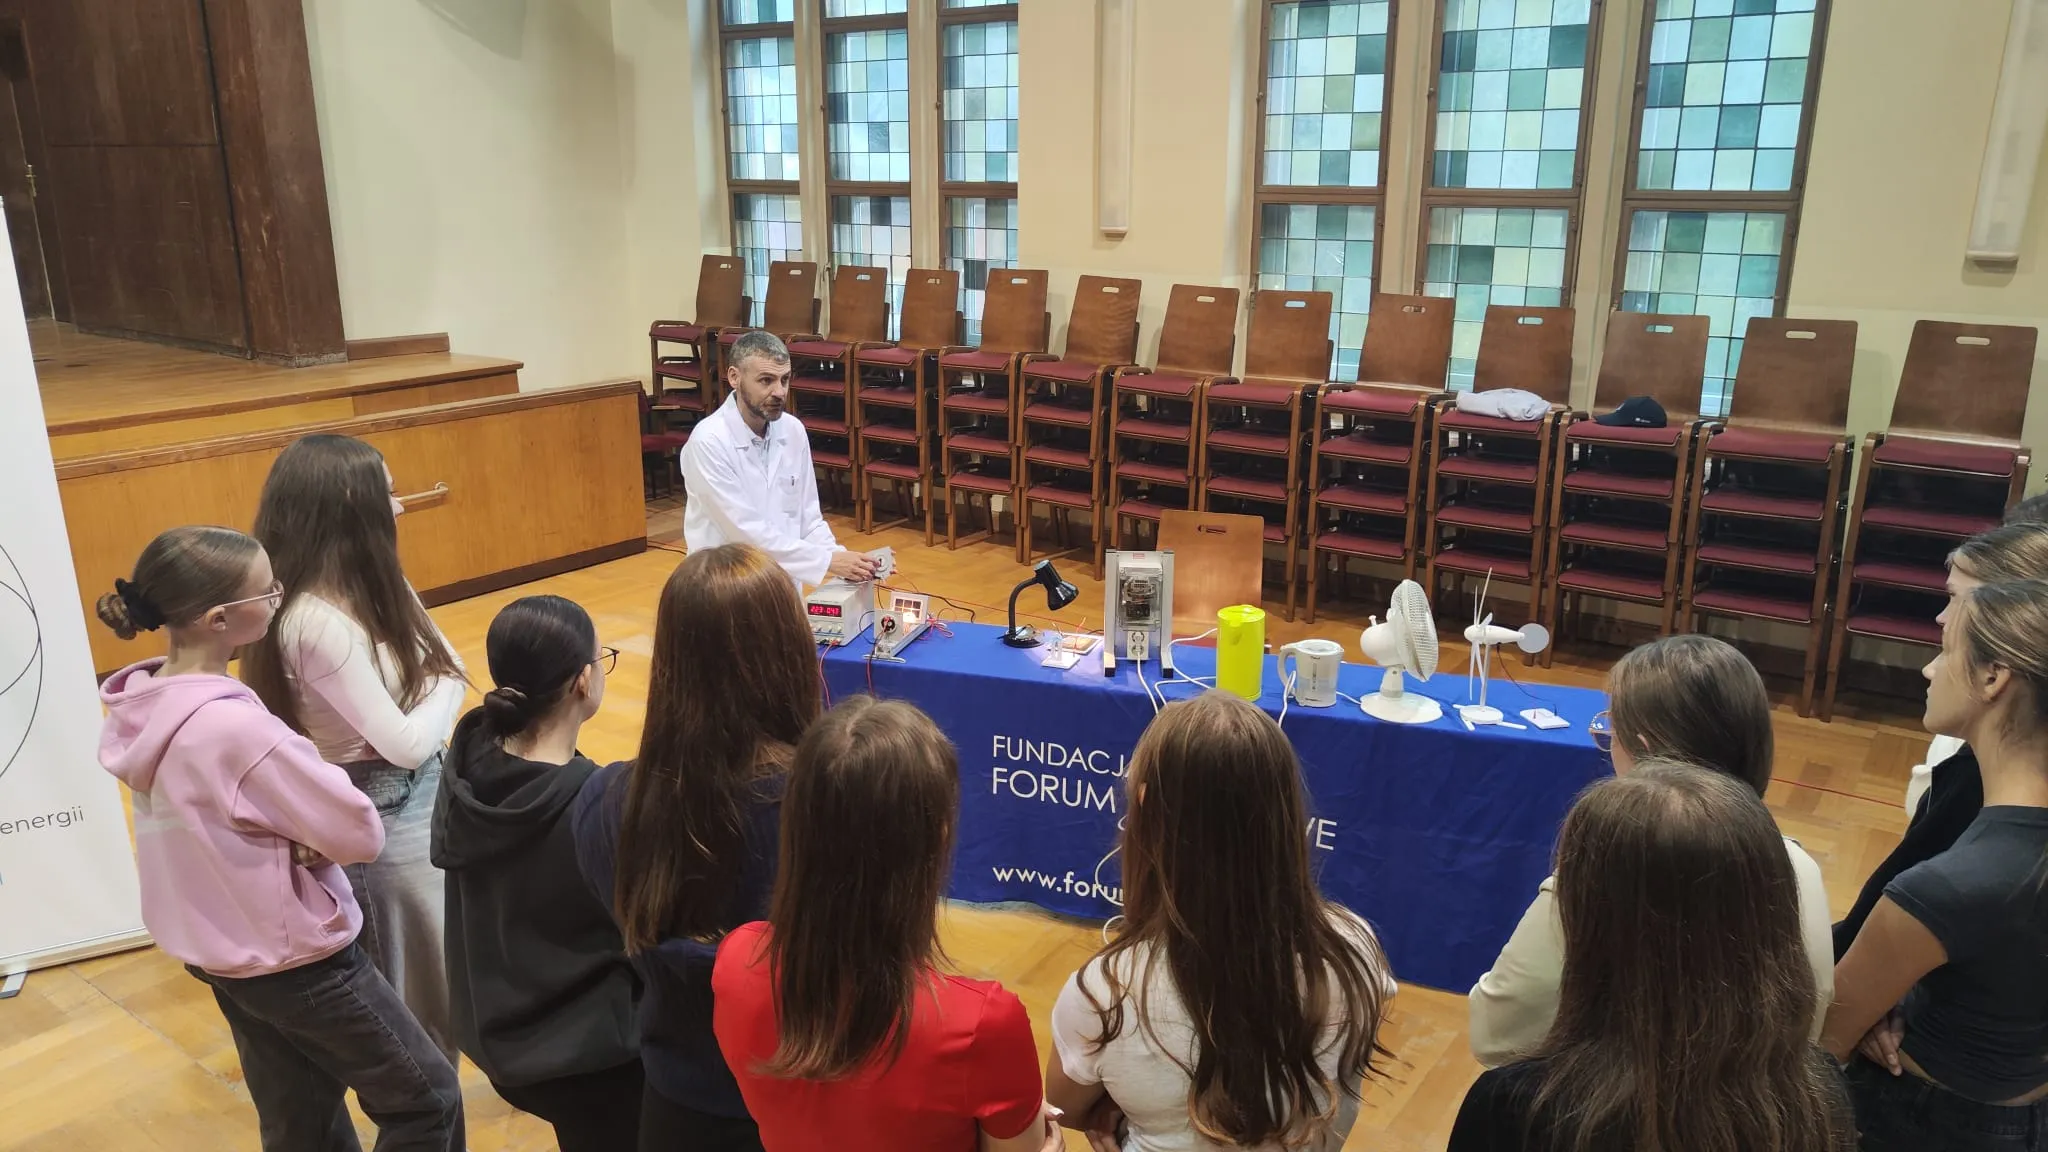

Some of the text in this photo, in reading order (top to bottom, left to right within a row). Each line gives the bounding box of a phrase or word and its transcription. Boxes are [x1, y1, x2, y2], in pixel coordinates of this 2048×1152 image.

[993, 735, 1129, 778] FUNDACJ
[993, 767, 1116, 814] FORUM
[0, 805, 84, 835] energii
[993, 867, 1124, 902] www.foru
